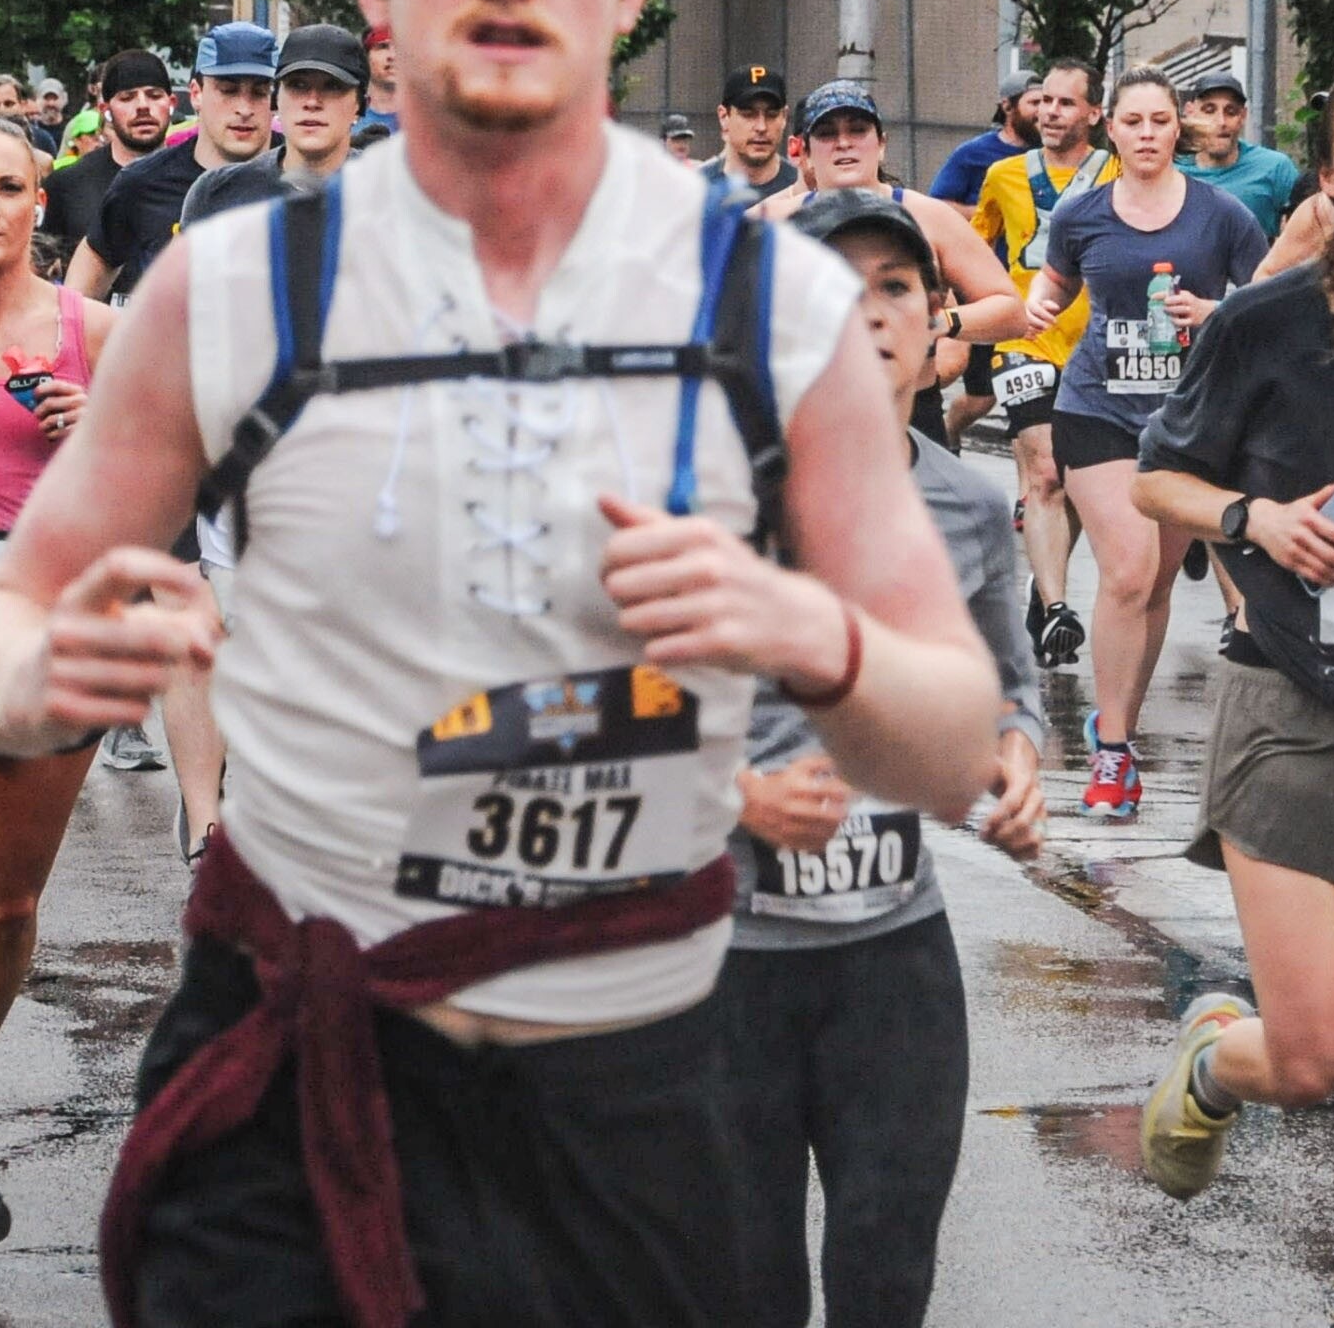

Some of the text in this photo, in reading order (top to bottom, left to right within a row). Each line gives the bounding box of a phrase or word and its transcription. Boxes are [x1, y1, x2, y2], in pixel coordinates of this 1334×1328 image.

[750, 66, 766, 84] P
[1116, 355, 1181, 380] 14950
[1006, 371, 1044, 395] 4938
[467, 792, 643, 871] 3617
[776, 829, 903, 896] 15570
